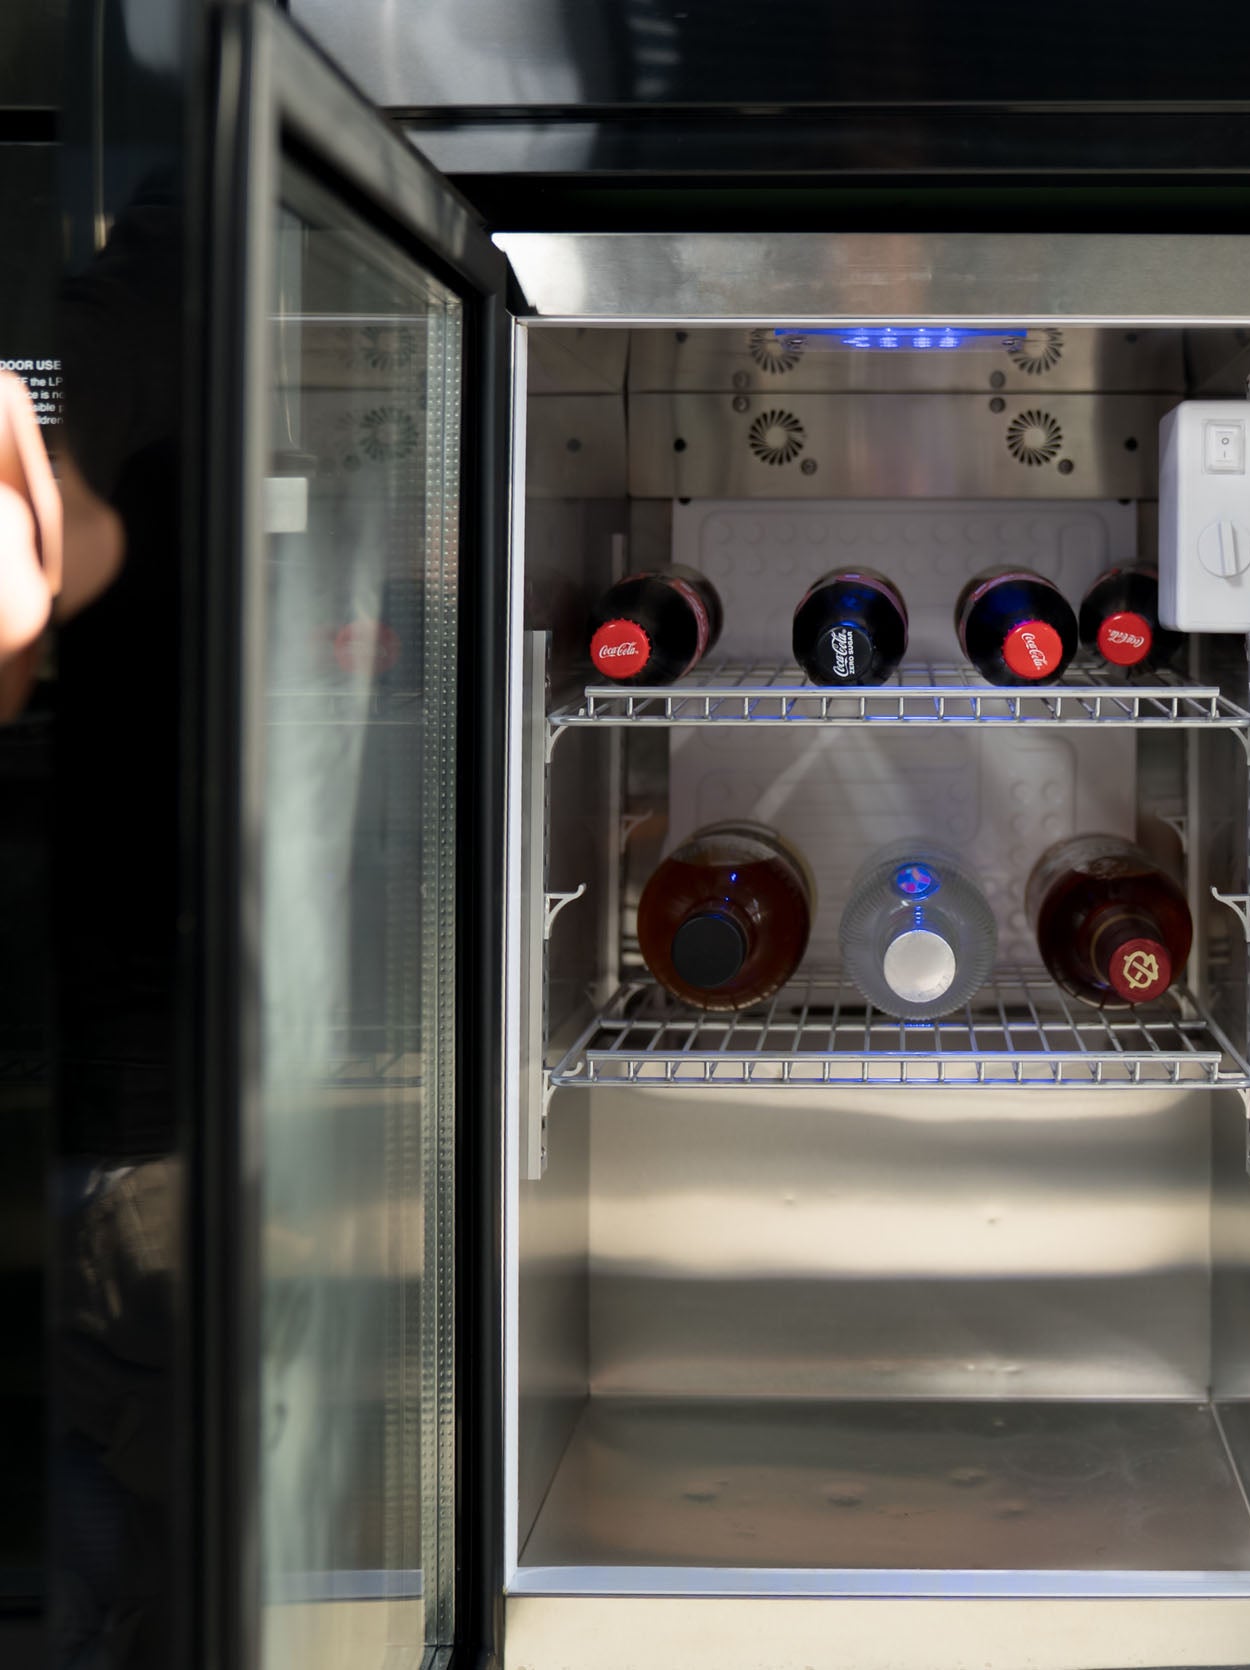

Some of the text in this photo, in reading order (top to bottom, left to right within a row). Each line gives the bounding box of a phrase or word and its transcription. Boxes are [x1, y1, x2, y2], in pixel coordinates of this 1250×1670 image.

[36, 360, 62, 371] USE
[599, 642, 639, 659] Coca-Cola
[831, 629, 849, 677] Coca-Cola
